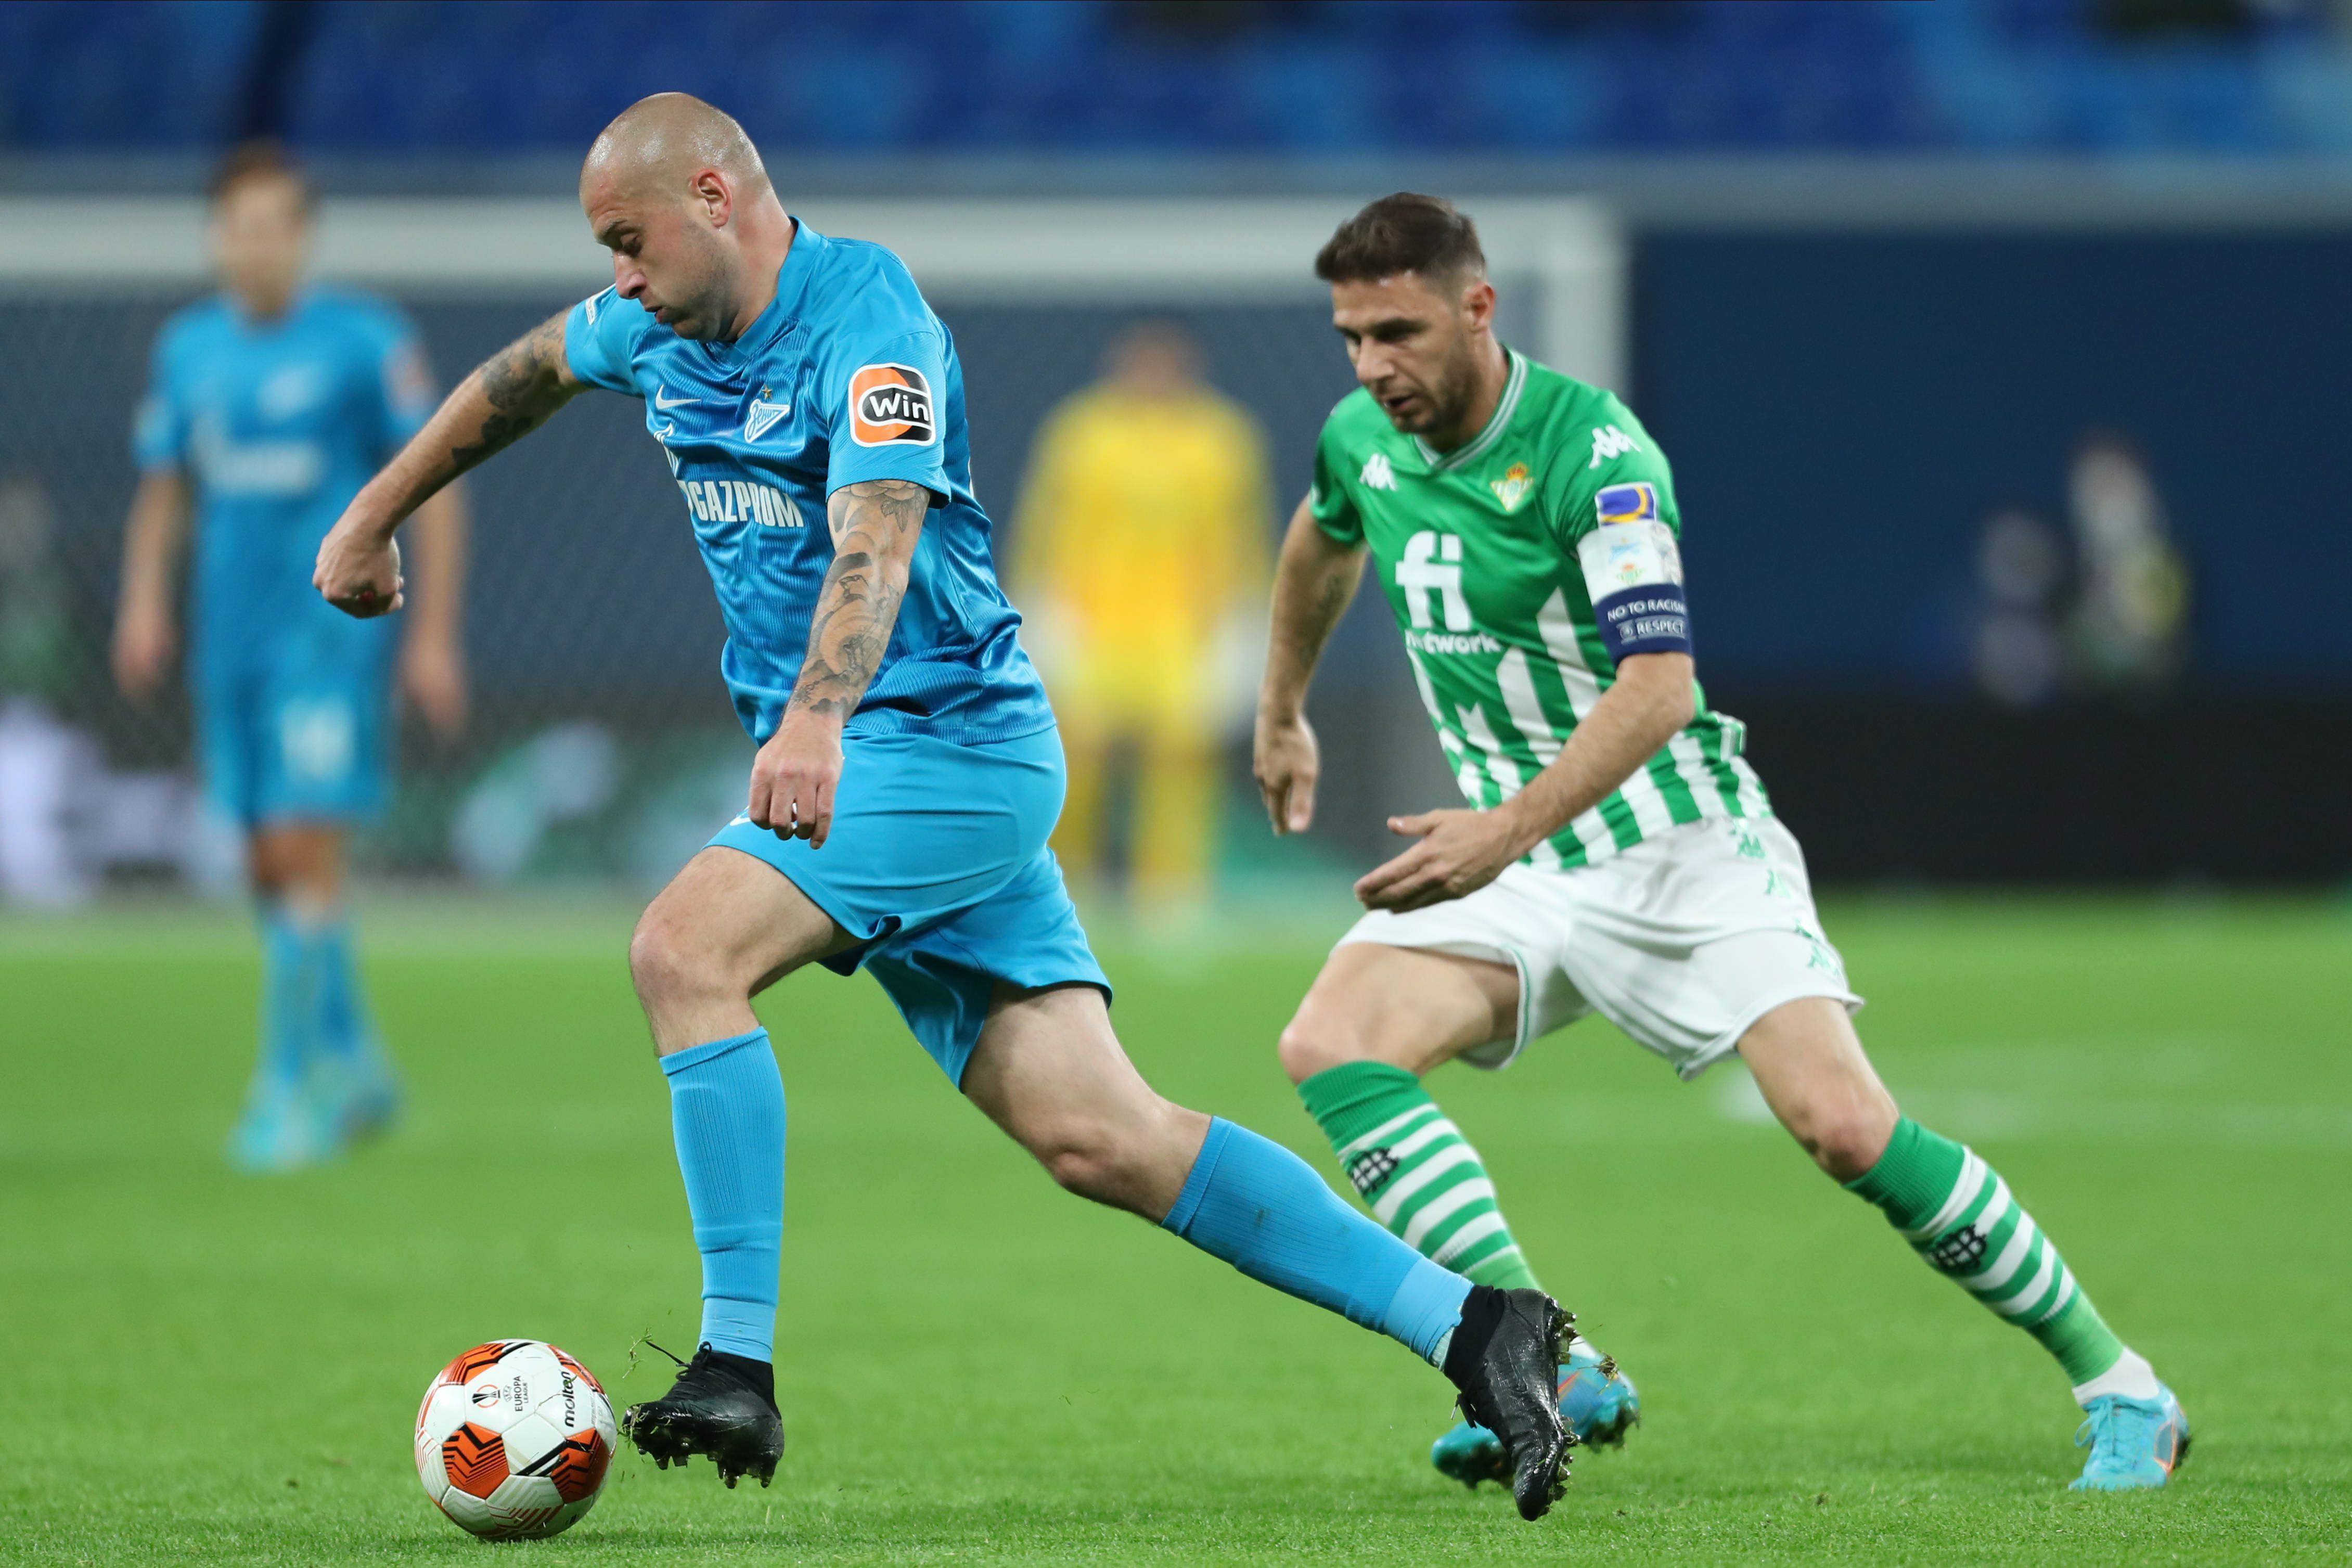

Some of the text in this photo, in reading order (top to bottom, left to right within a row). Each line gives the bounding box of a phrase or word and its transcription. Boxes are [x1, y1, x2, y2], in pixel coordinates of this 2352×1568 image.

[869, 393, 929, 421] Win
[1608, 605, 1626, 622] NO
[1627, 600, 1646, 614] TO
[1637, 619, 1684, 634] RESPECT
[513, 1376, 523, 1411] EUROPA
[561, 1371, 575, 1428] molten
